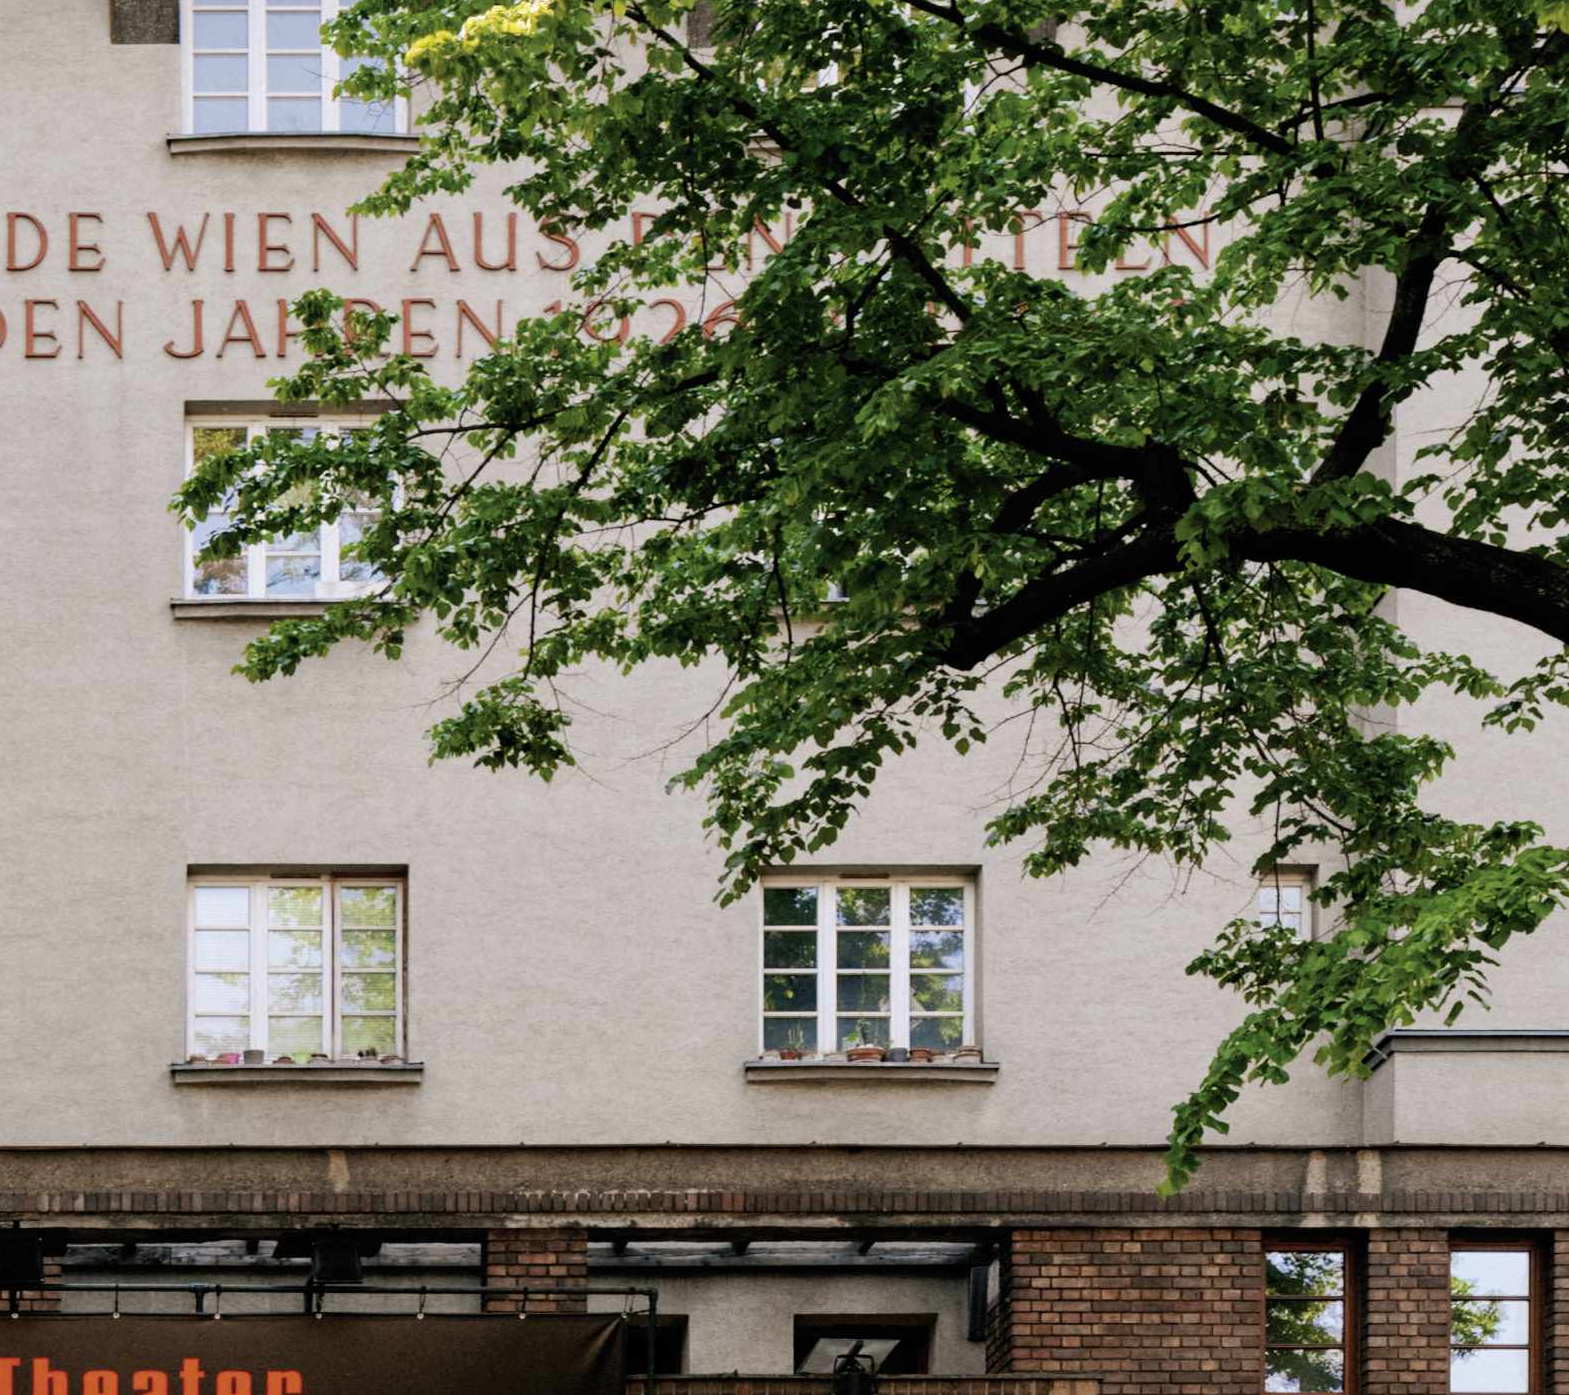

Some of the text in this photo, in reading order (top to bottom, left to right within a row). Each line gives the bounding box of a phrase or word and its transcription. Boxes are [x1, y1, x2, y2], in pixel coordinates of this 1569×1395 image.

[147, 211, 359, 273] WIEN
[410, 211, 580, 272] AUS
[632, 211, 793, 272] DN
[163, 297, 503, 360] JAHREN
[543, 297, 751, 358] 926
